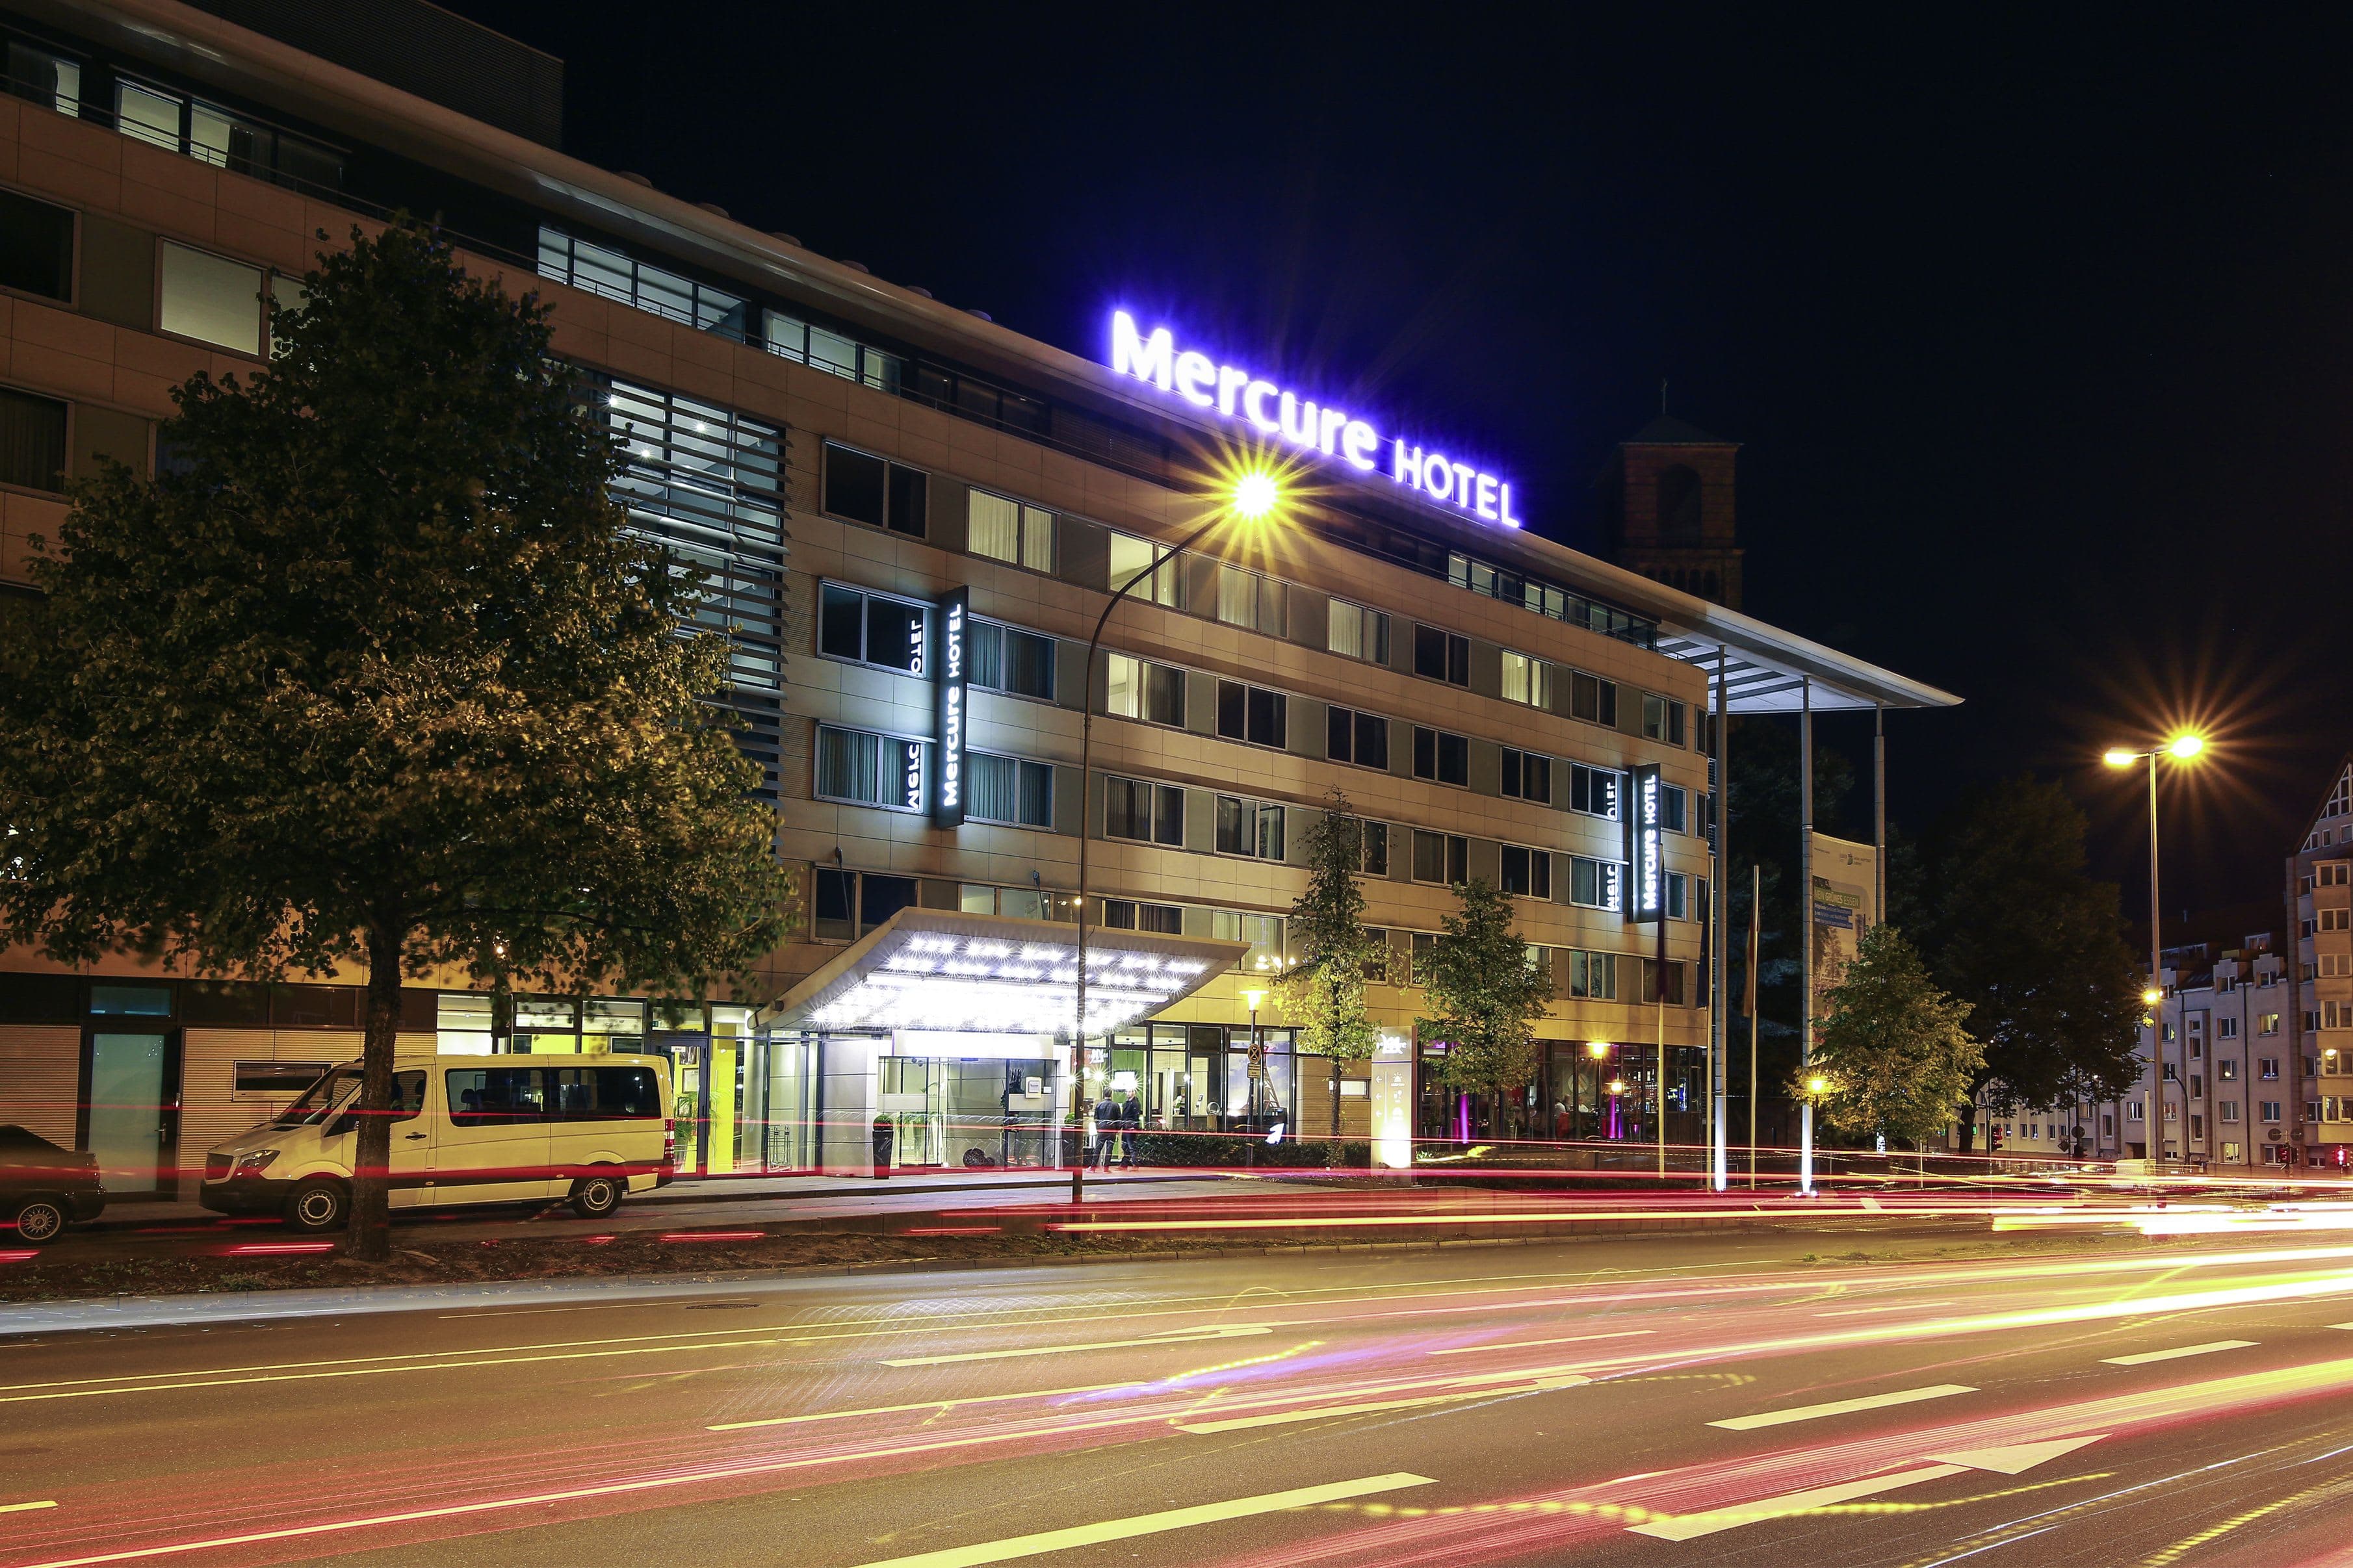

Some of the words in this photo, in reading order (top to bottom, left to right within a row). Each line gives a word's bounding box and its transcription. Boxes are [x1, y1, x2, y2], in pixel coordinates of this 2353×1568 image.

[1113, 310, 1377, 470] Mercure
[1396, 439, 1520, 528] HOTEL
[948, 602, 961, 678] HOTEL
[943, 686, 960, 807] Mercure
[1644, 774, 1656, 825] HOTEL
[1643, 829, 1657, 910] Mercure
